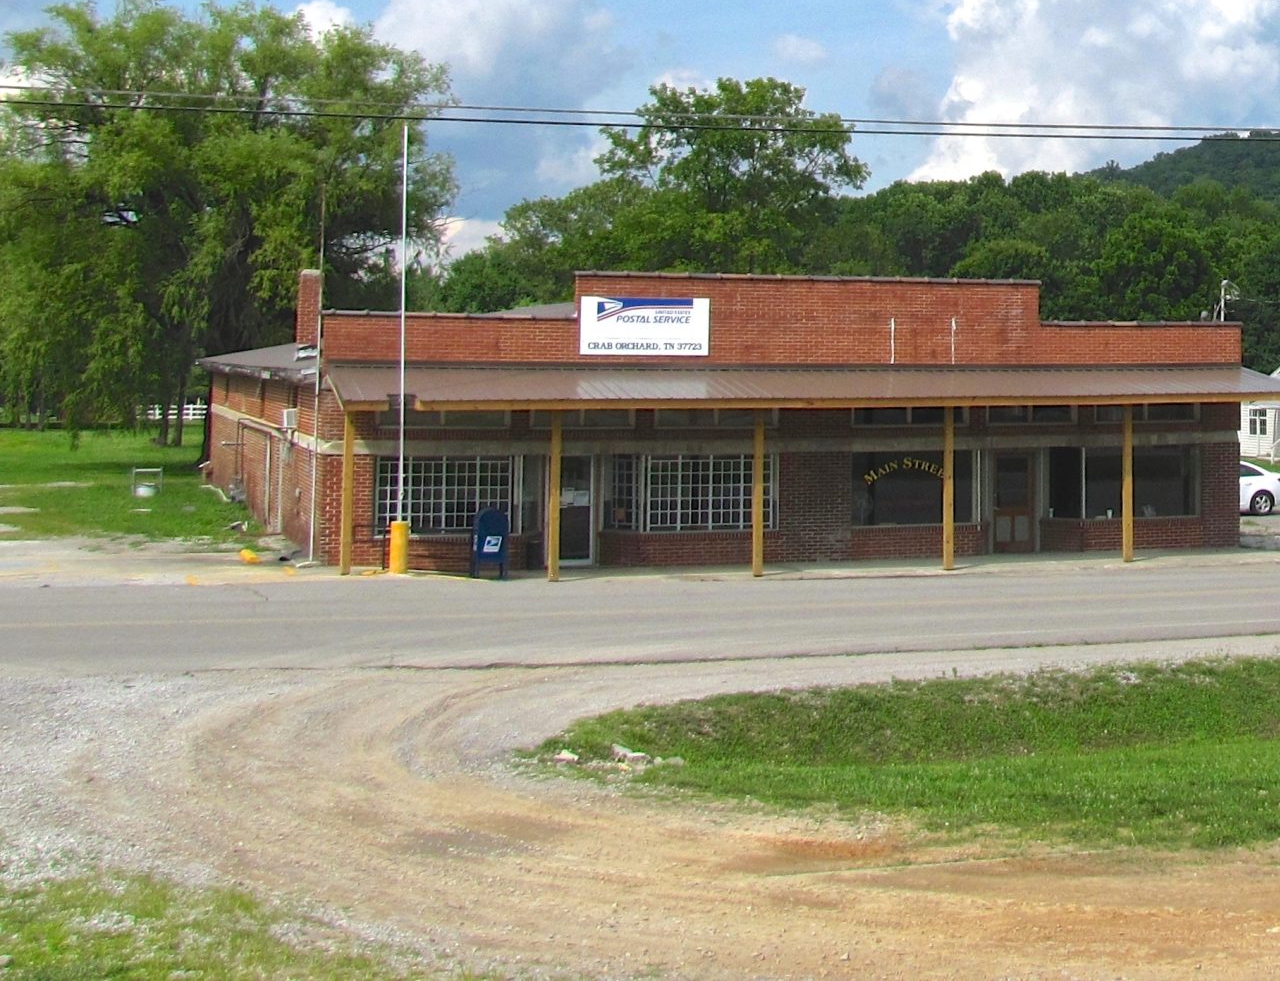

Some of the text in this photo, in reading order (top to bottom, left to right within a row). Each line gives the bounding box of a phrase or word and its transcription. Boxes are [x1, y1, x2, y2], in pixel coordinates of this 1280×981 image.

[616, 315, 691, 324] POSTAL SERVICE
[587, 342, 702, 351] CRAB ORCHARD, TN 37723
[863, 457, 945, 485] MAIN STREE
